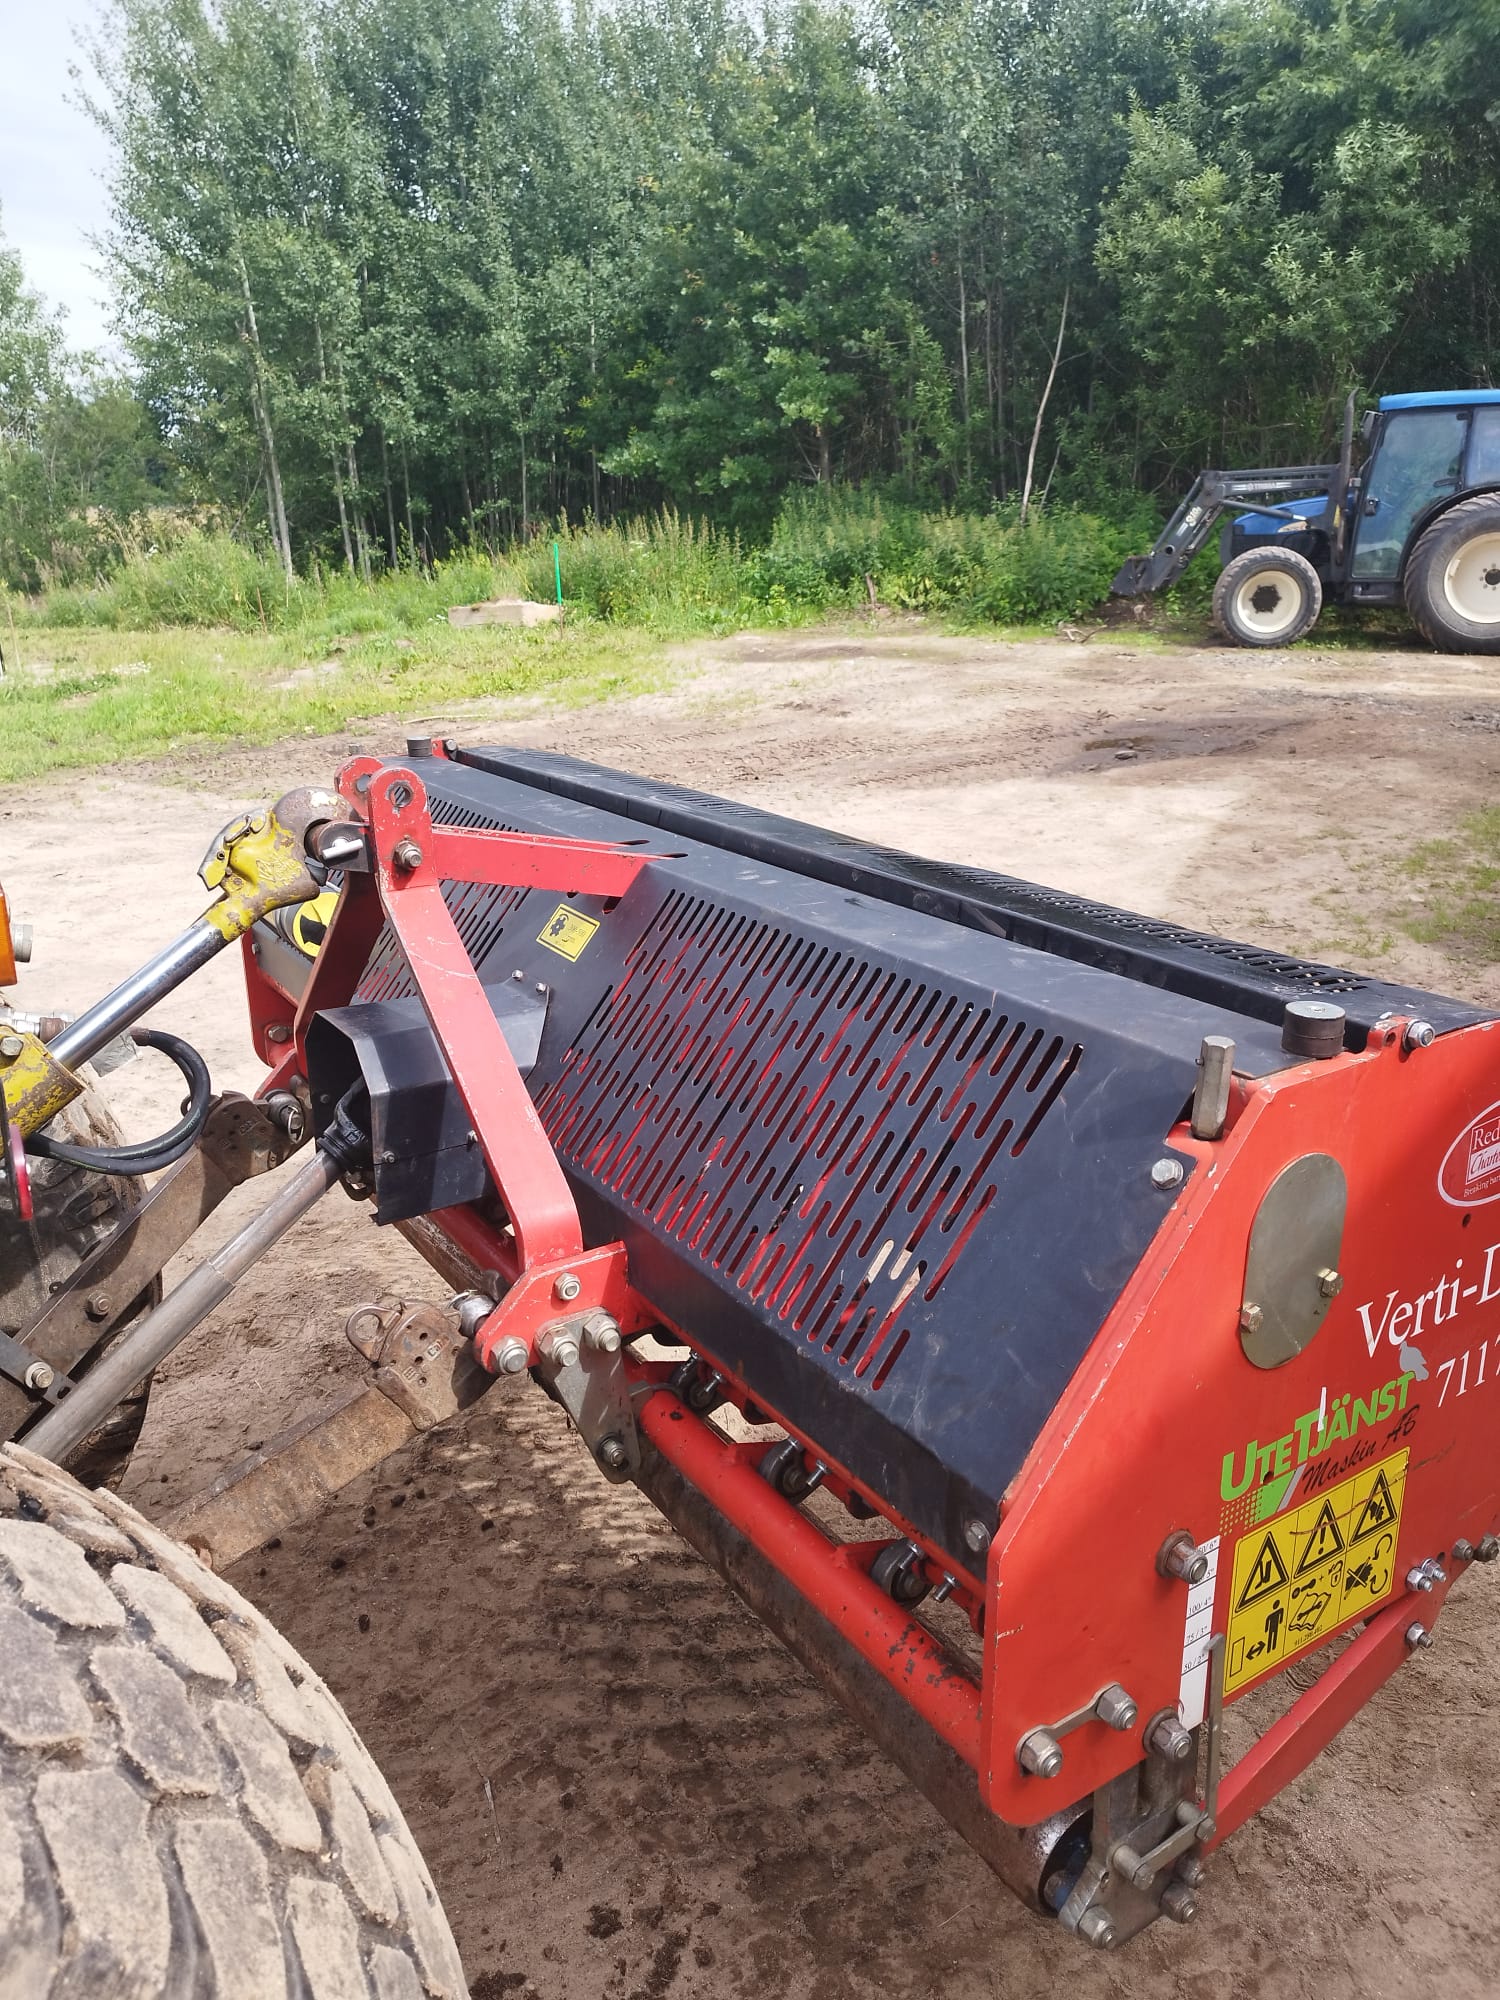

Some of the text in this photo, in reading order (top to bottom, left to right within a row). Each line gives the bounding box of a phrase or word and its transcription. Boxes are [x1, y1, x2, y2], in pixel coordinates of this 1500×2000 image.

[1472, 1119, 1500, 1150] Red
[1436, 1334, 1500, 1408] 711
[1302, 1439, 1378, 1494] Maskin
